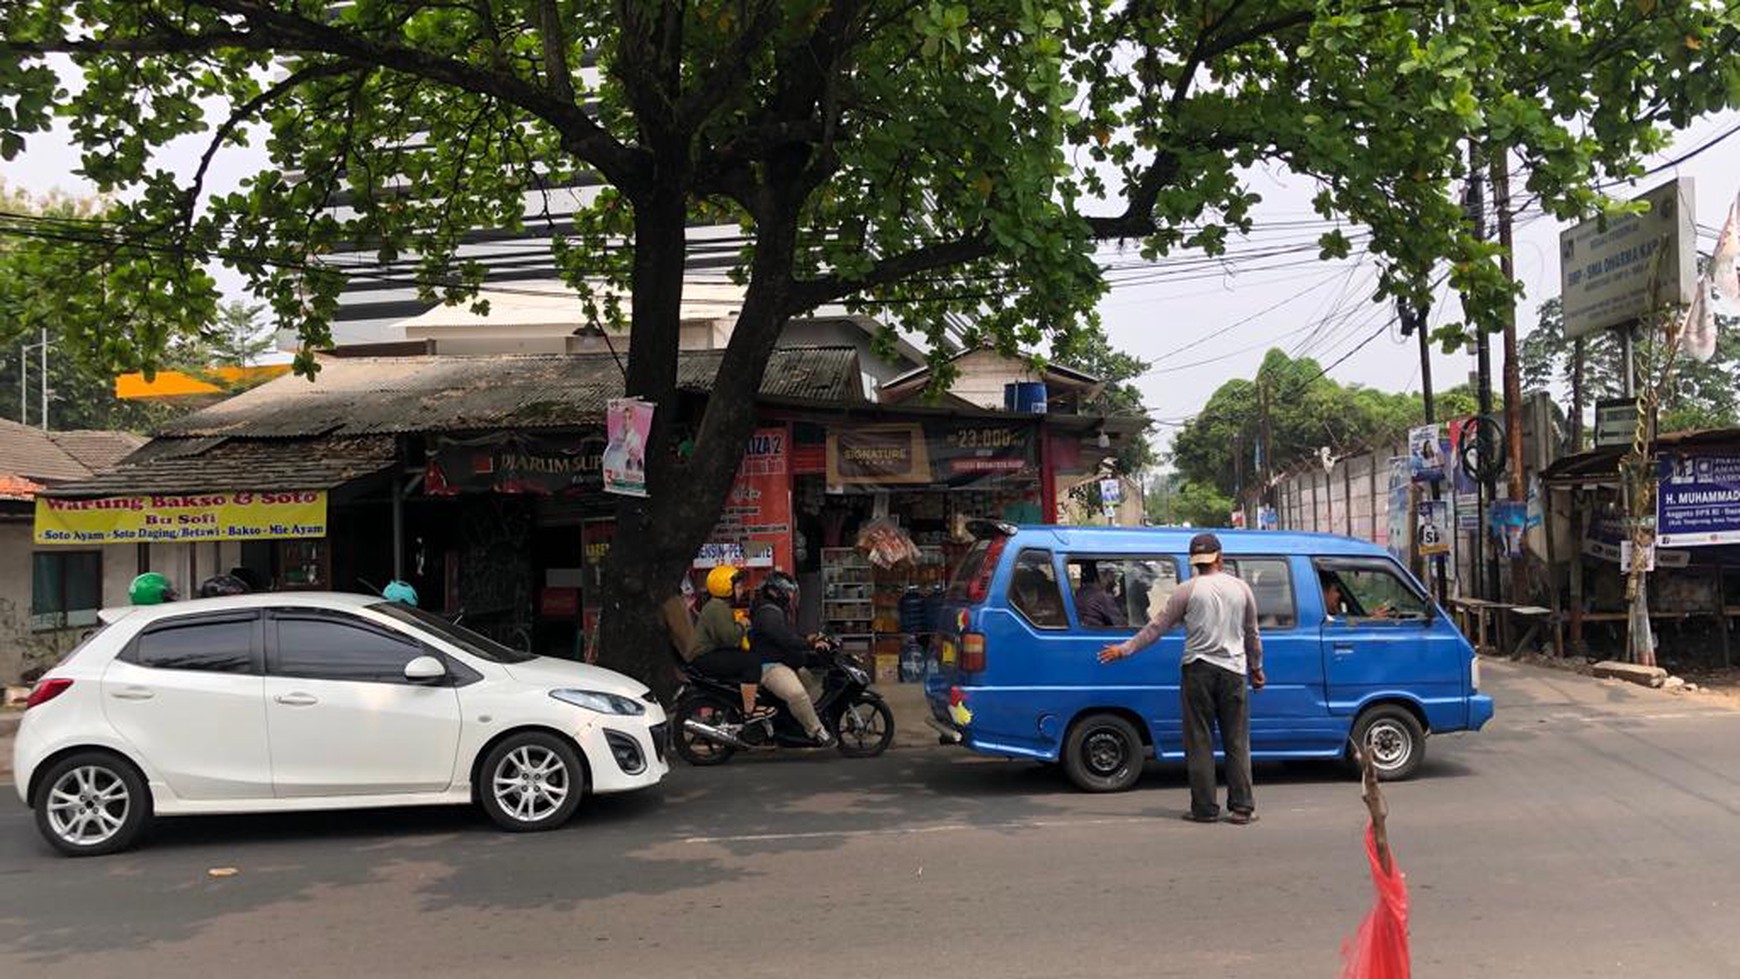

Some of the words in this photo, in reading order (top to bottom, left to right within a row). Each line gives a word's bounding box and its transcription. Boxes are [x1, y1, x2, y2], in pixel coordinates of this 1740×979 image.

[843, 447, 907, 460] SIGNATURE
[151, 493, 227, 509] Bakso
[261, 488, 319, 505] Soto
[145, 514, 173, 525] Bu
[178, 513, 217, 525] Sofi
[44, 529, 71, 540] Soto
[73, 529, 105, 541] Ayam
[228, 525, 261, 536] Bakso
[292, 523, 324, 535] Ayam
